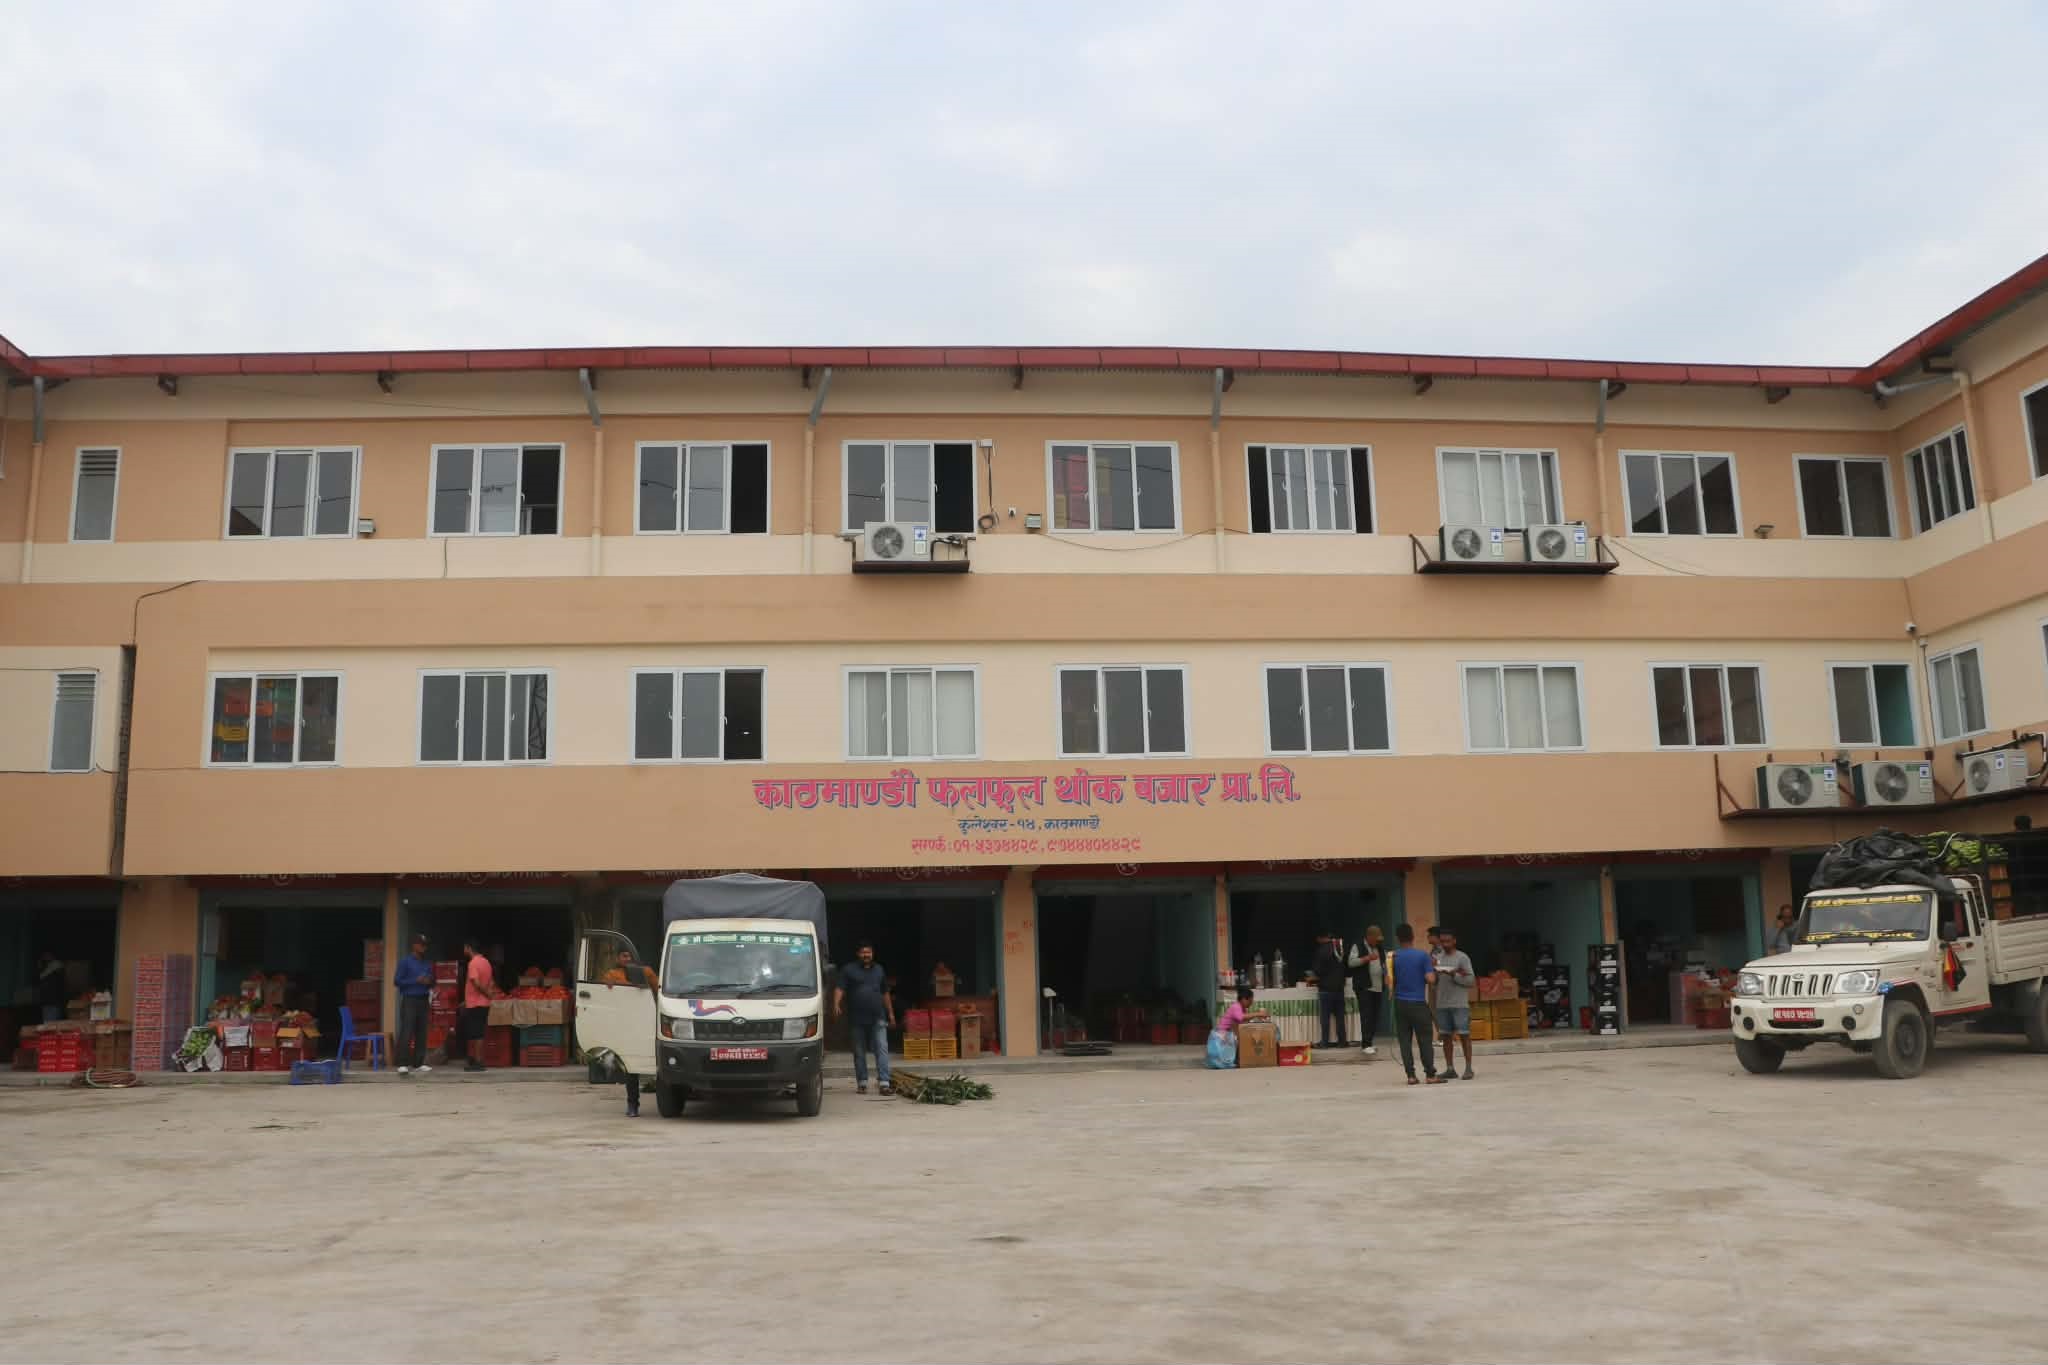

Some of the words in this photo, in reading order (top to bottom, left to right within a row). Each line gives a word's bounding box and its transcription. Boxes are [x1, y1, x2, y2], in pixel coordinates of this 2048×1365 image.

[926, 775, 1048, 813] फलफूल
[1054, 768, 1127, 806] थोक
[1133, 773, 1217, 806] बजार
